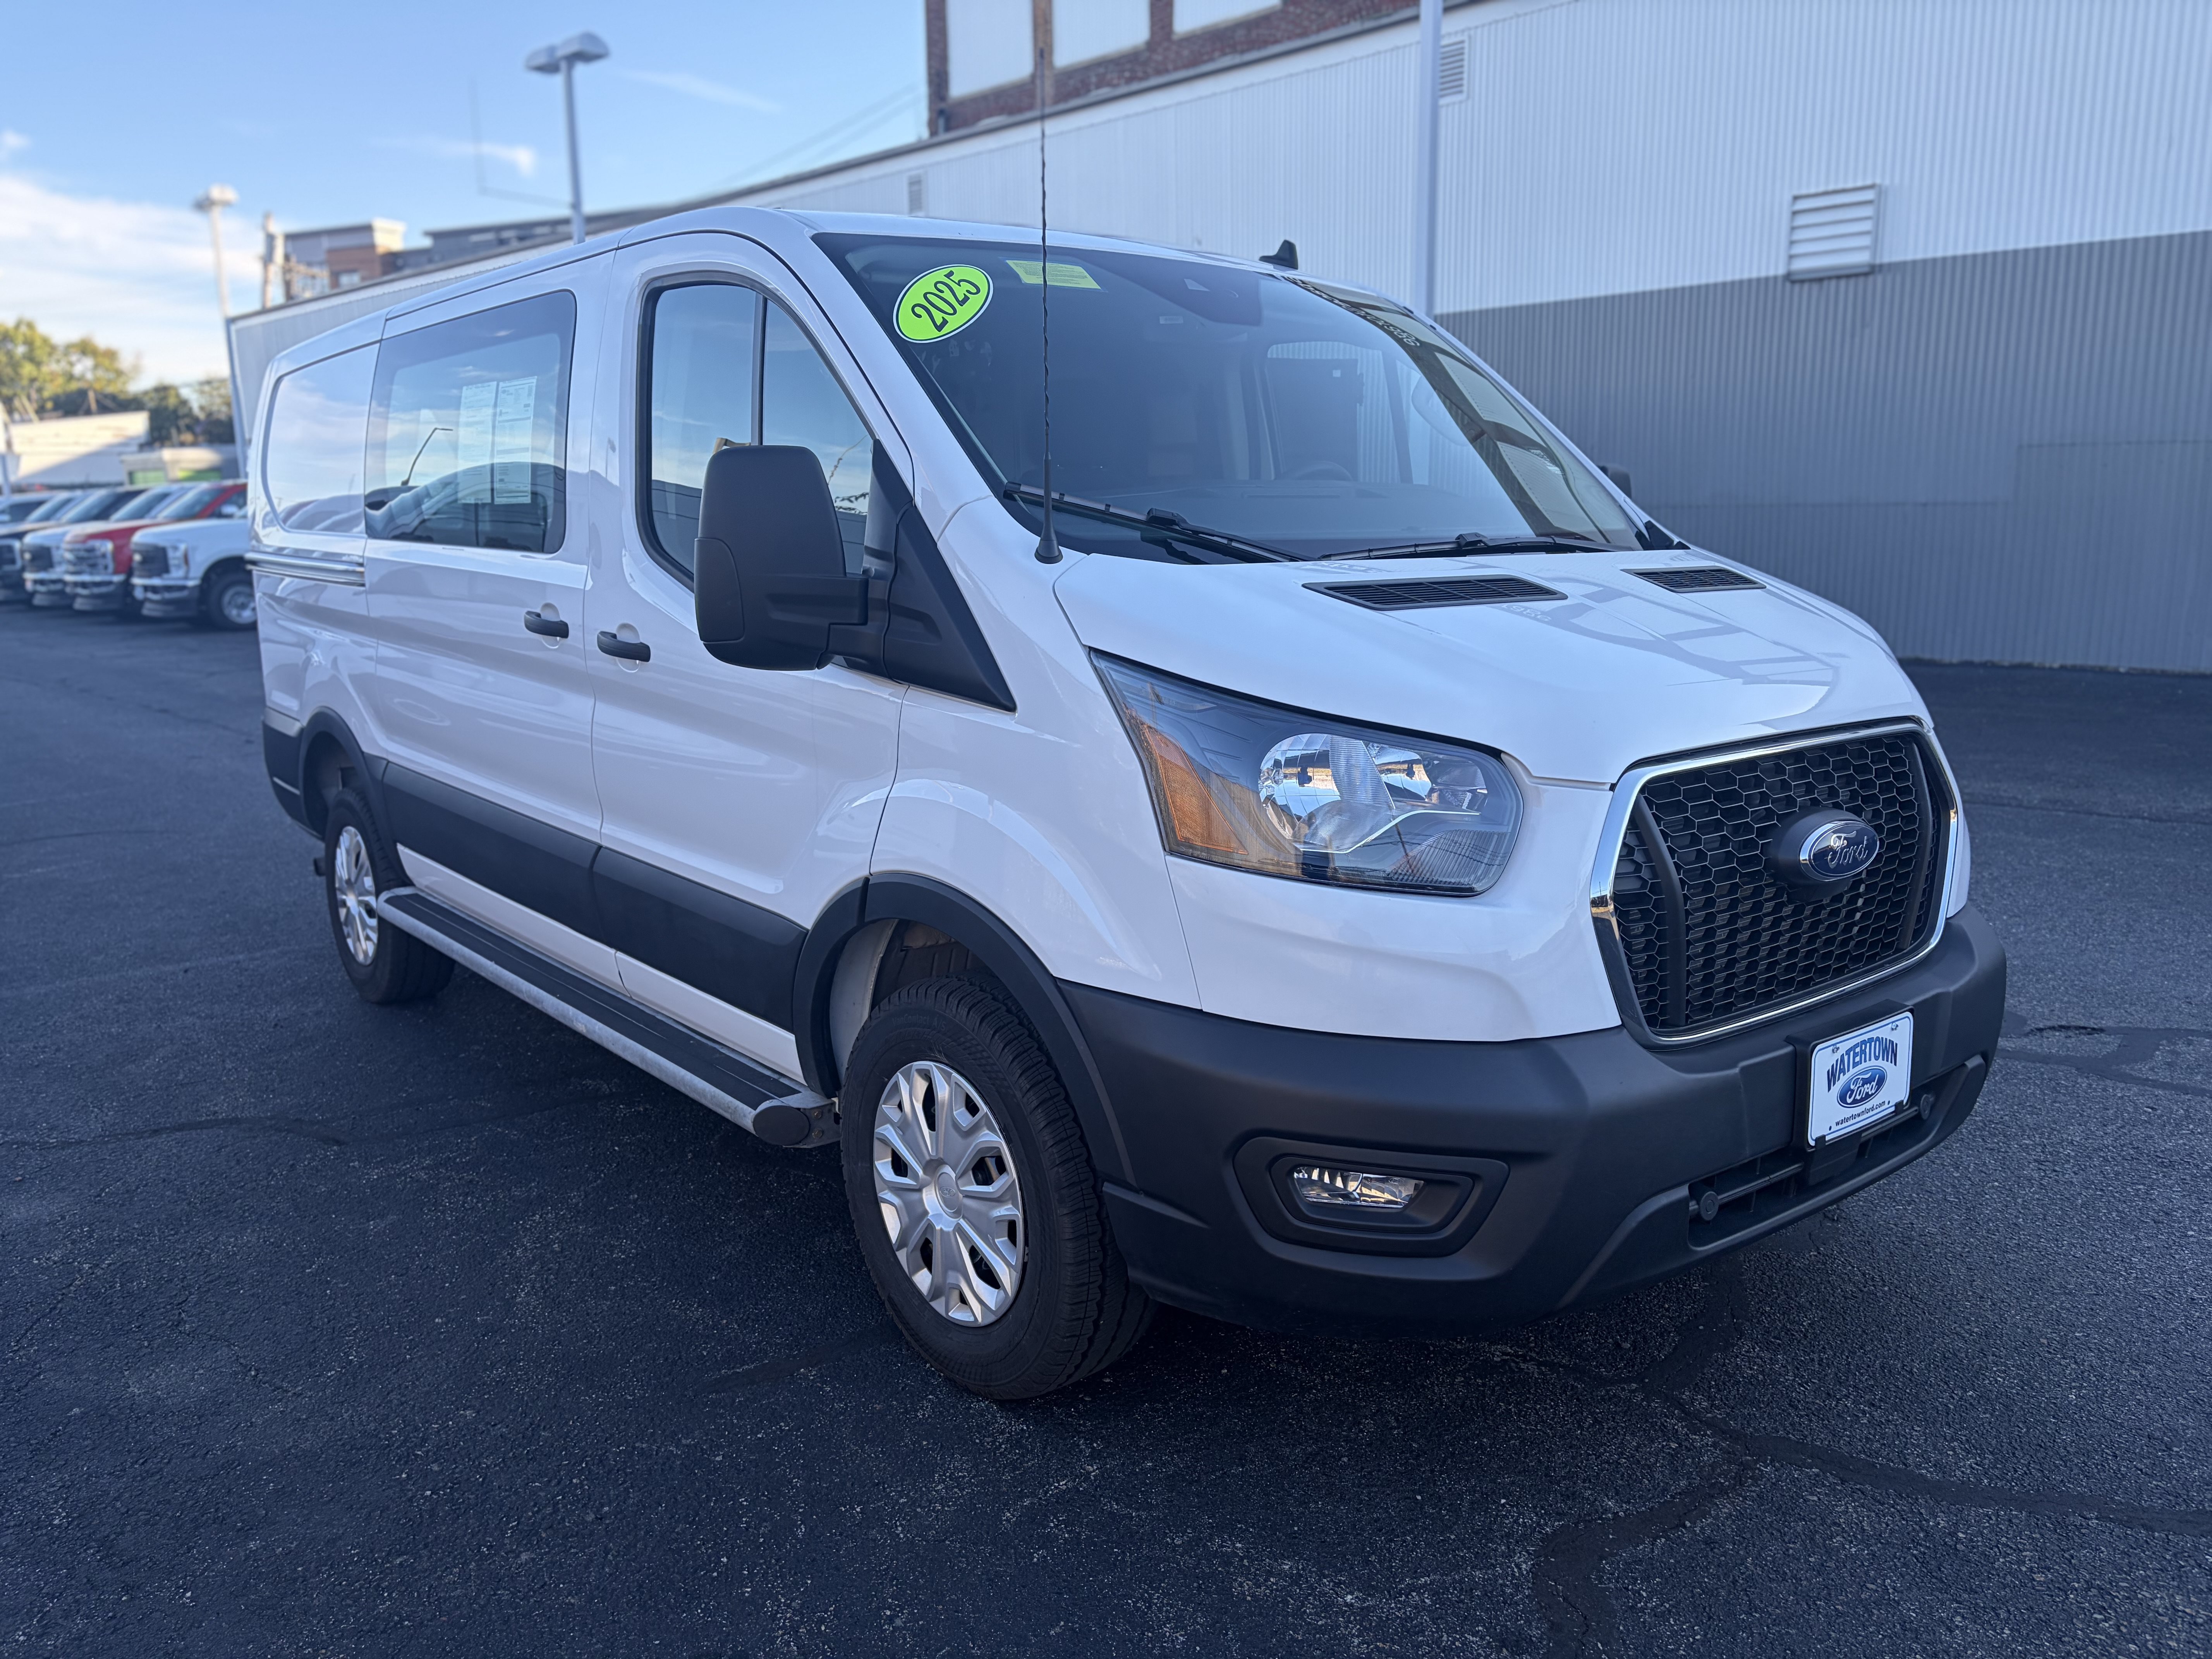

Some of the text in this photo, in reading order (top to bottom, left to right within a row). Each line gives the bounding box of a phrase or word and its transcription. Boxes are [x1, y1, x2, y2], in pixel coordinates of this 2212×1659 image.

[911, 270, 981, 332] 2025
[1827, 831, 1868, 869] Ford
[1827, 1036, 1898, 1093] WATERTOWN
[1846, 1072, 1880, 1103] Ford
[1835, 1100, 1886, 1127] watertownford.com
